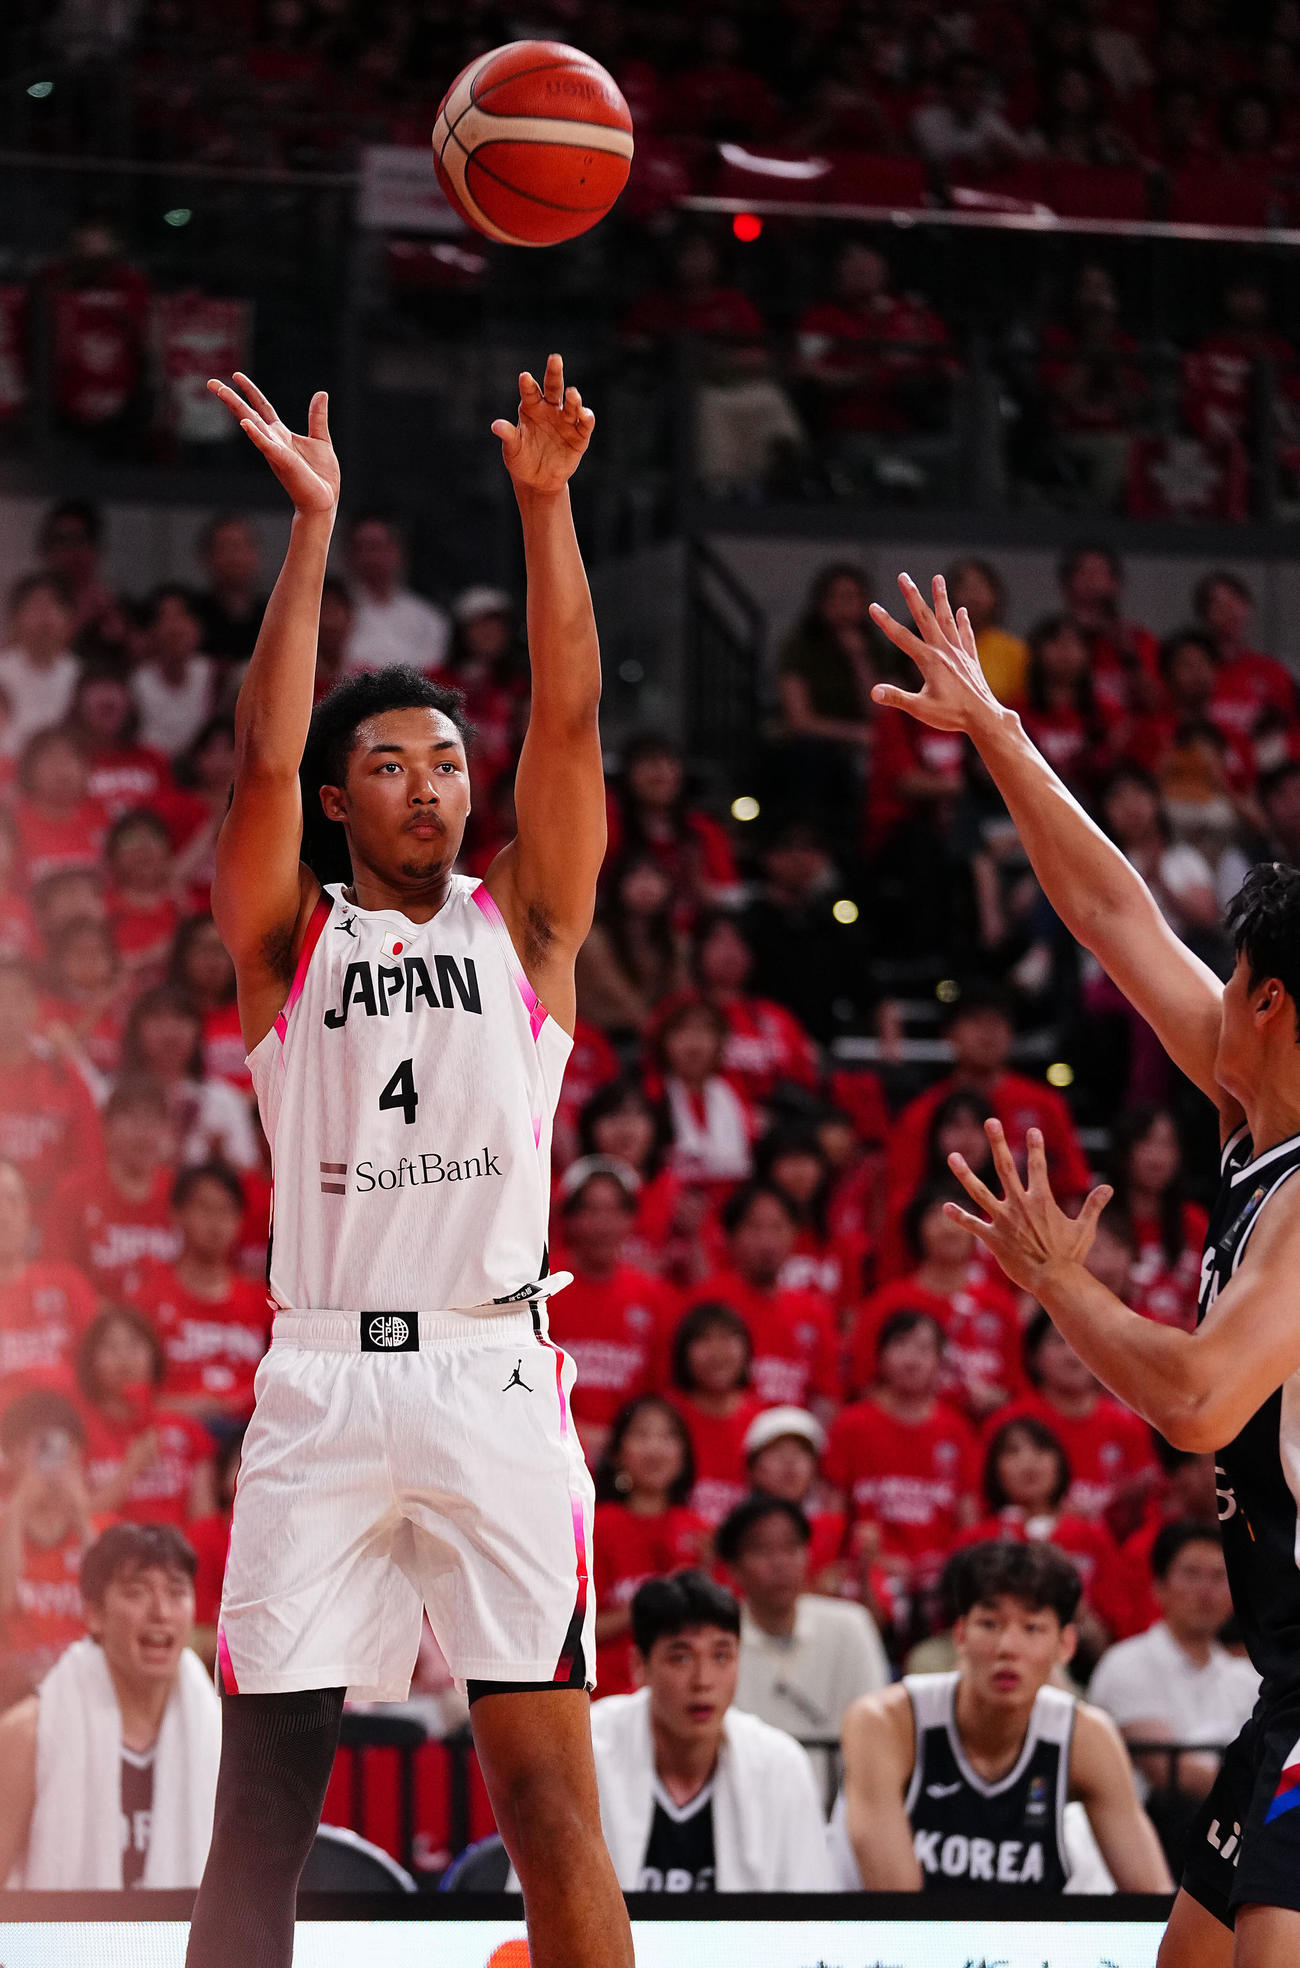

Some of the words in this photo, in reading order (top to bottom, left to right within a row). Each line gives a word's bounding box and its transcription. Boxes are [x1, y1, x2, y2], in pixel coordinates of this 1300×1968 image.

[324, 955, 482, 1029] JAPAN
[379, 1058, 418, 1125] 4
[356, 1147, 502, 1192] SoftBank
[385, 1316, 393, 1347] JPN
[914, 1829, 1044, 1883] KOREA
